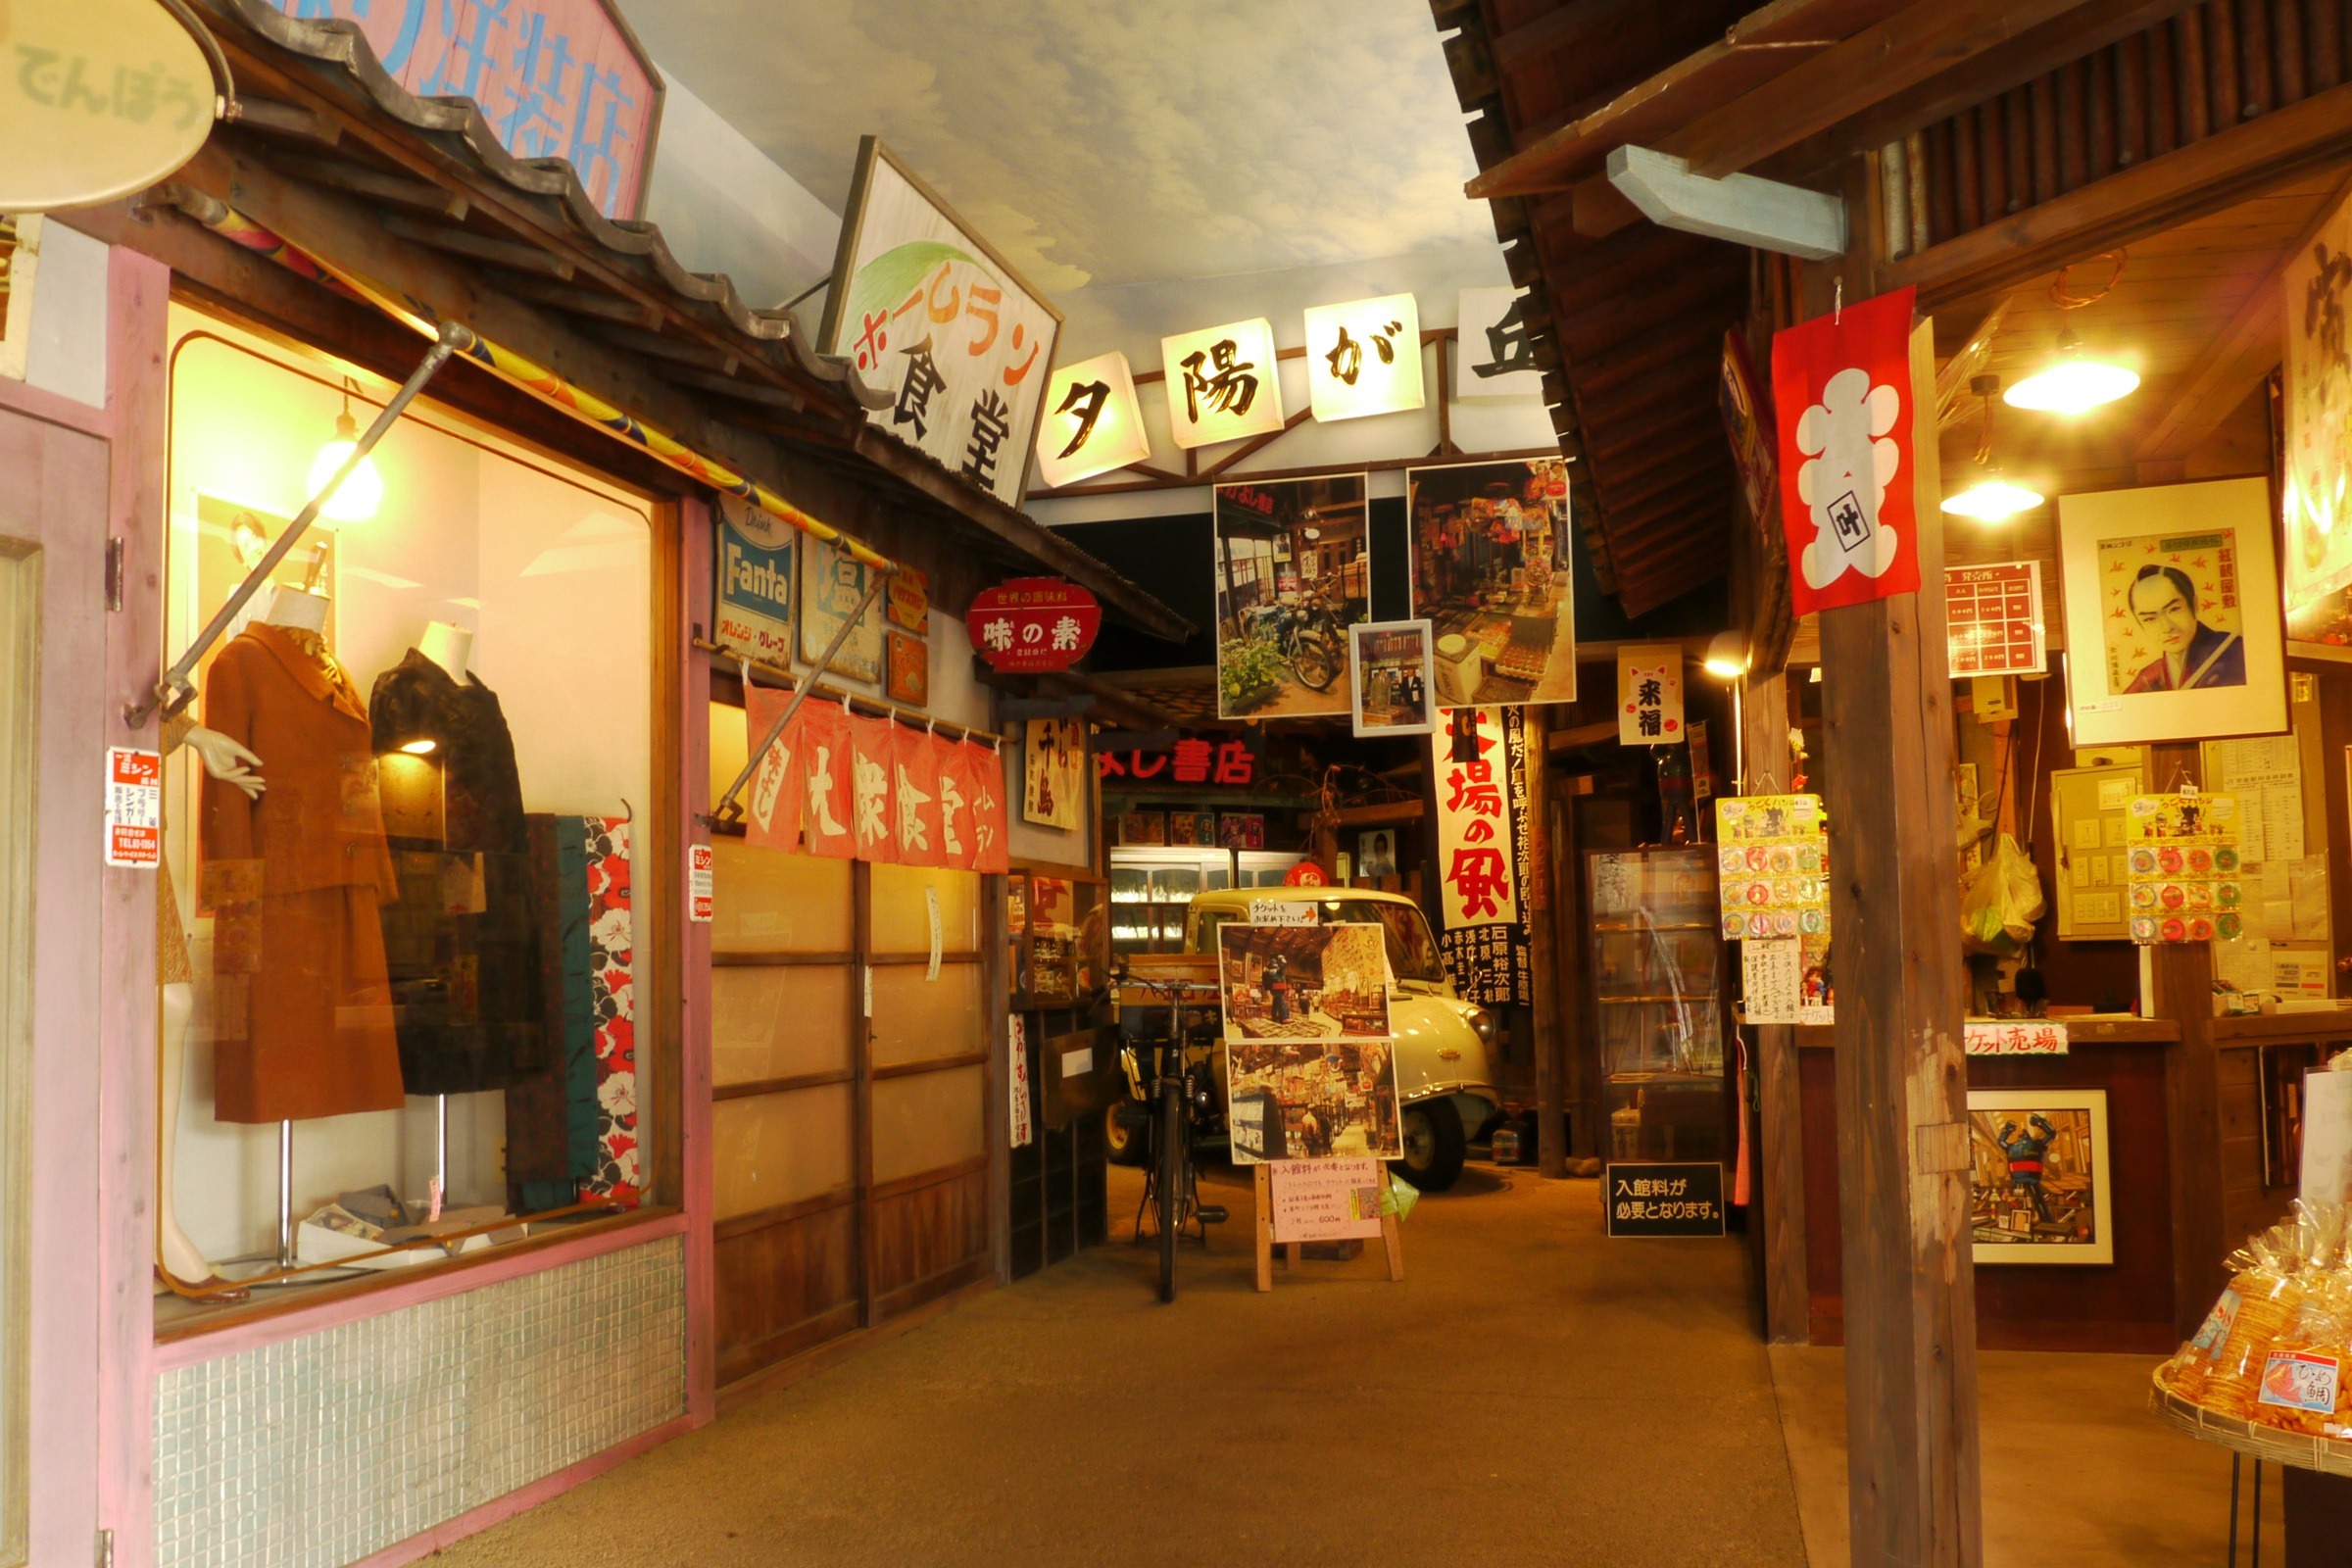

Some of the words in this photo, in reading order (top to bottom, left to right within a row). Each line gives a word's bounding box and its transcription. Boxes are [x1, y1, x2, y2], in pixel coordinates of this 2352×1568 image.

[854, 261, 1039, 386] ホームラン
[894, 332, 1009, 491] 食堂
[745, 507, 772, 535] Drink
[726, 542, 788, 606] Fanta
[2218, 548, 2236, 609] 紅鶴屋敷
[983, 615, 1081, 652] 味の素
[1639, 679, 1661, 736] 来福
[120, 761, 153, 775] ミシン
[124, 787, 134, 825] シンガー
[809, 745, 964, 856] 大衆食堂
[1492, 926, 1510, 1003] 石原裕次郎
[1964, 1026, 2057, 1054] ケット売場
[1616, 1179, 1688, 1198] 入館料が
[1617, 1201, 1719, 1220] 必要となります。
